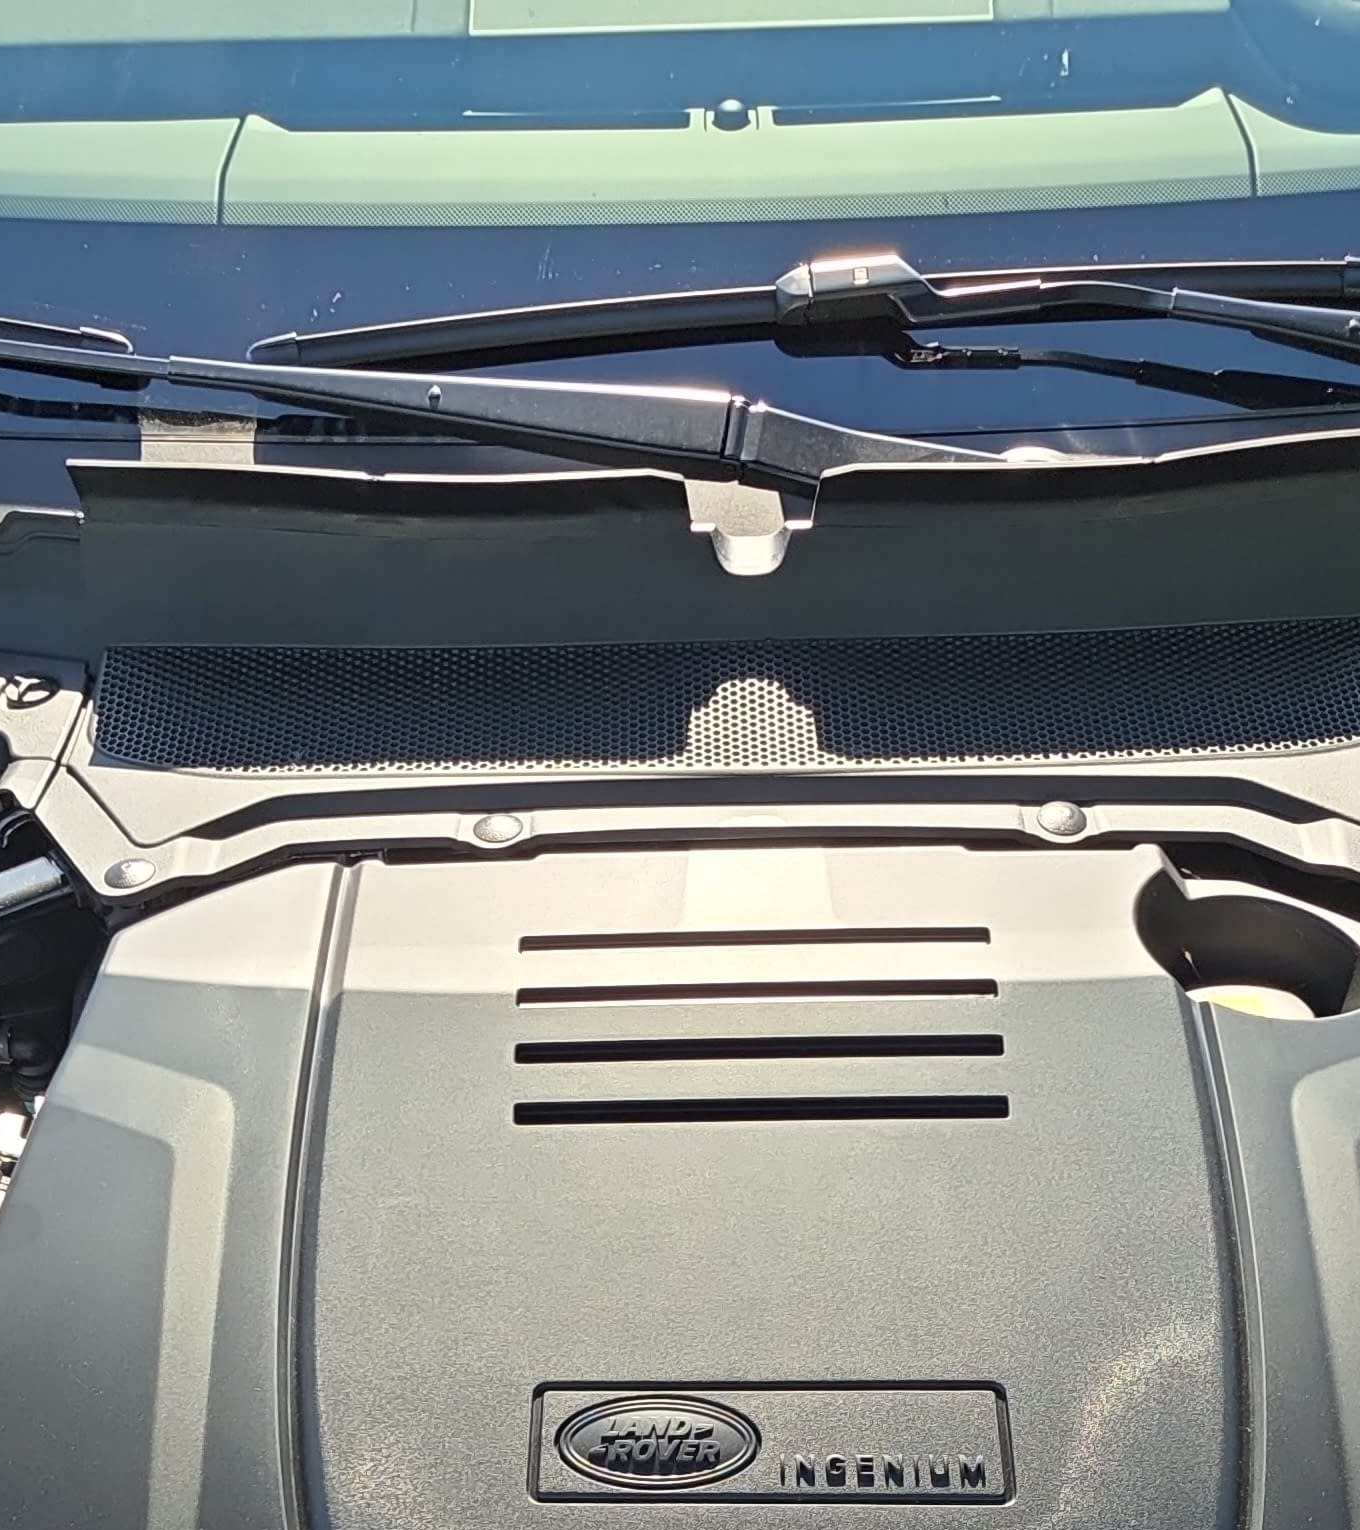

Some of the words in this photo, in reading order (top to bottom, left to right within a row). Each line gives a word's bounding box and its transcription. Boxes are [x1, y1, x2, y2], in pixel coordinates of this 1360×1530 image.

[608, 1416, 690, 1439] LAND
[606, 1438, 721, 1467] ROVER
[779, 1453, 987, 1488] INGENIUM
